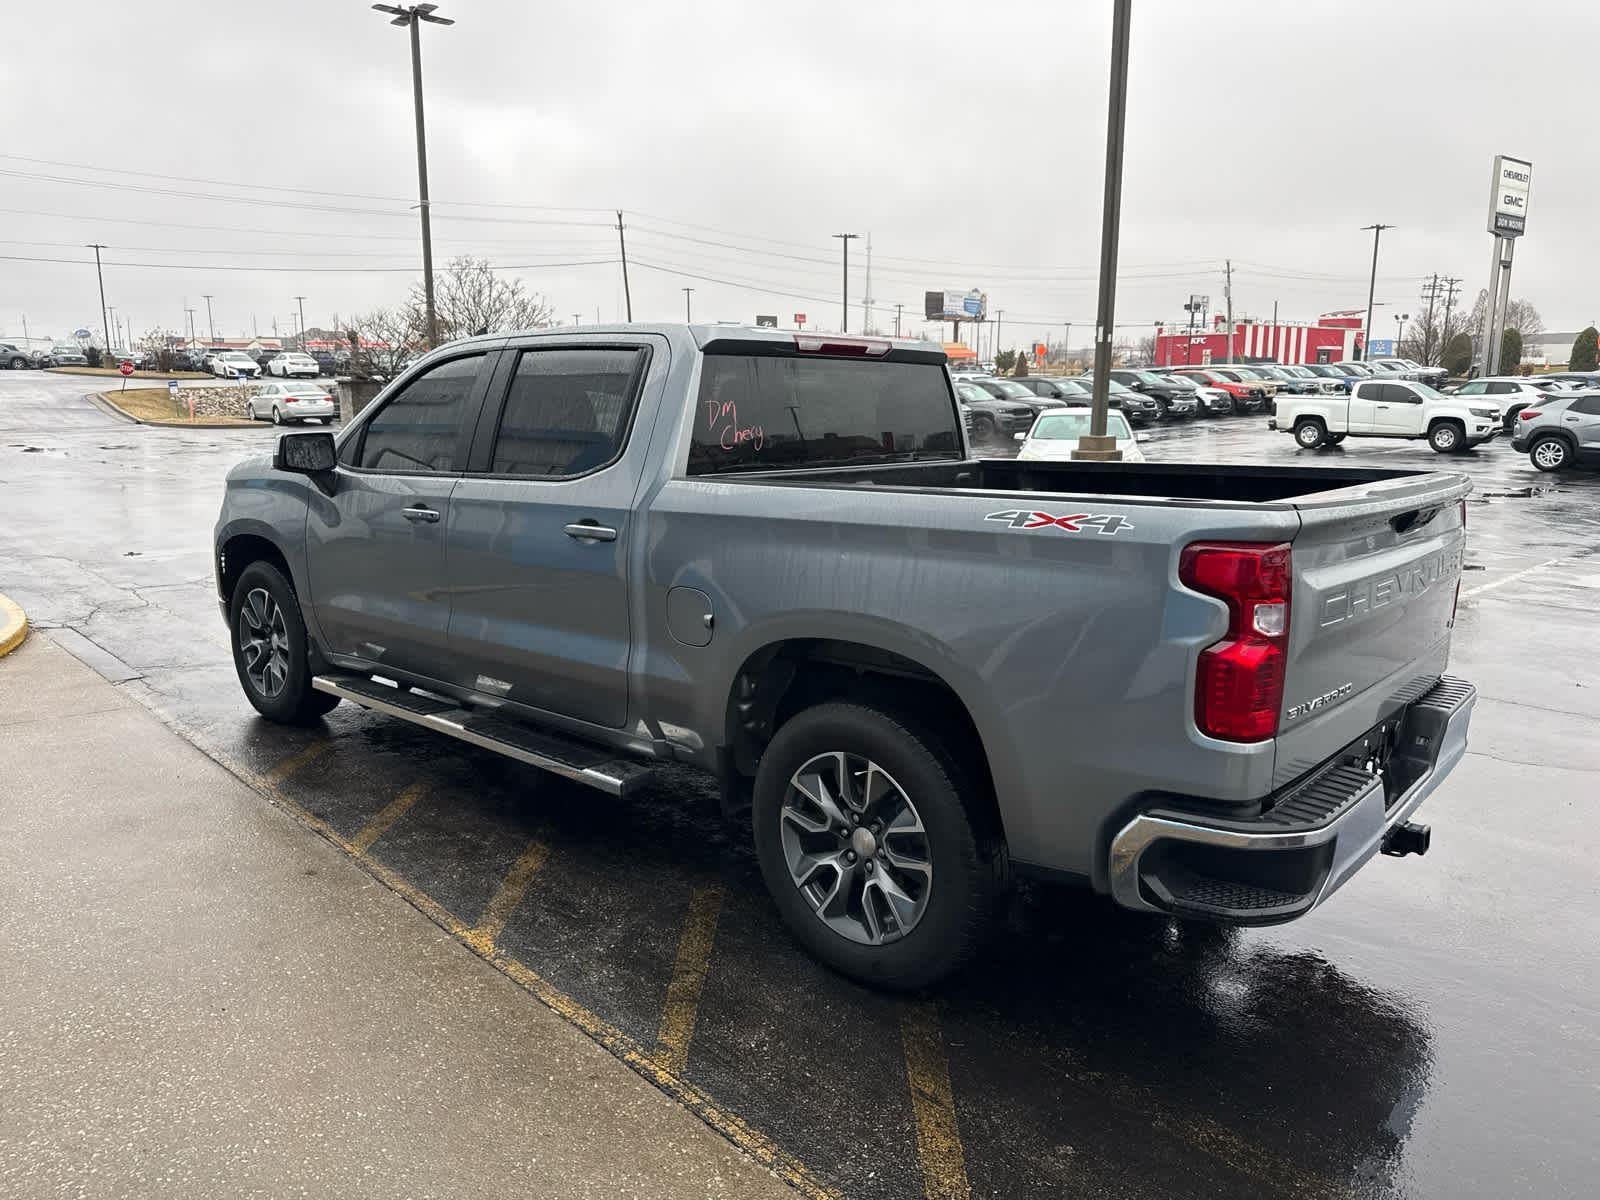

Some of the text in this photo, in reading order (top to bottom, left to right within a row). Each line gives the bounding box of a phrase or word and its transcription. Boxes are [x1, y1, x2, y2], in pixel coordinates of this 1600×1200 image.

[1503, 169, 1529, 183] CHEVROLET
[1503, 194, 1524, 208] GMC
[1190, 337, 1207, 345] KFC
[704, 399, 737, 431] DM
[1287, 682, 1353, 720] SILVERADO
